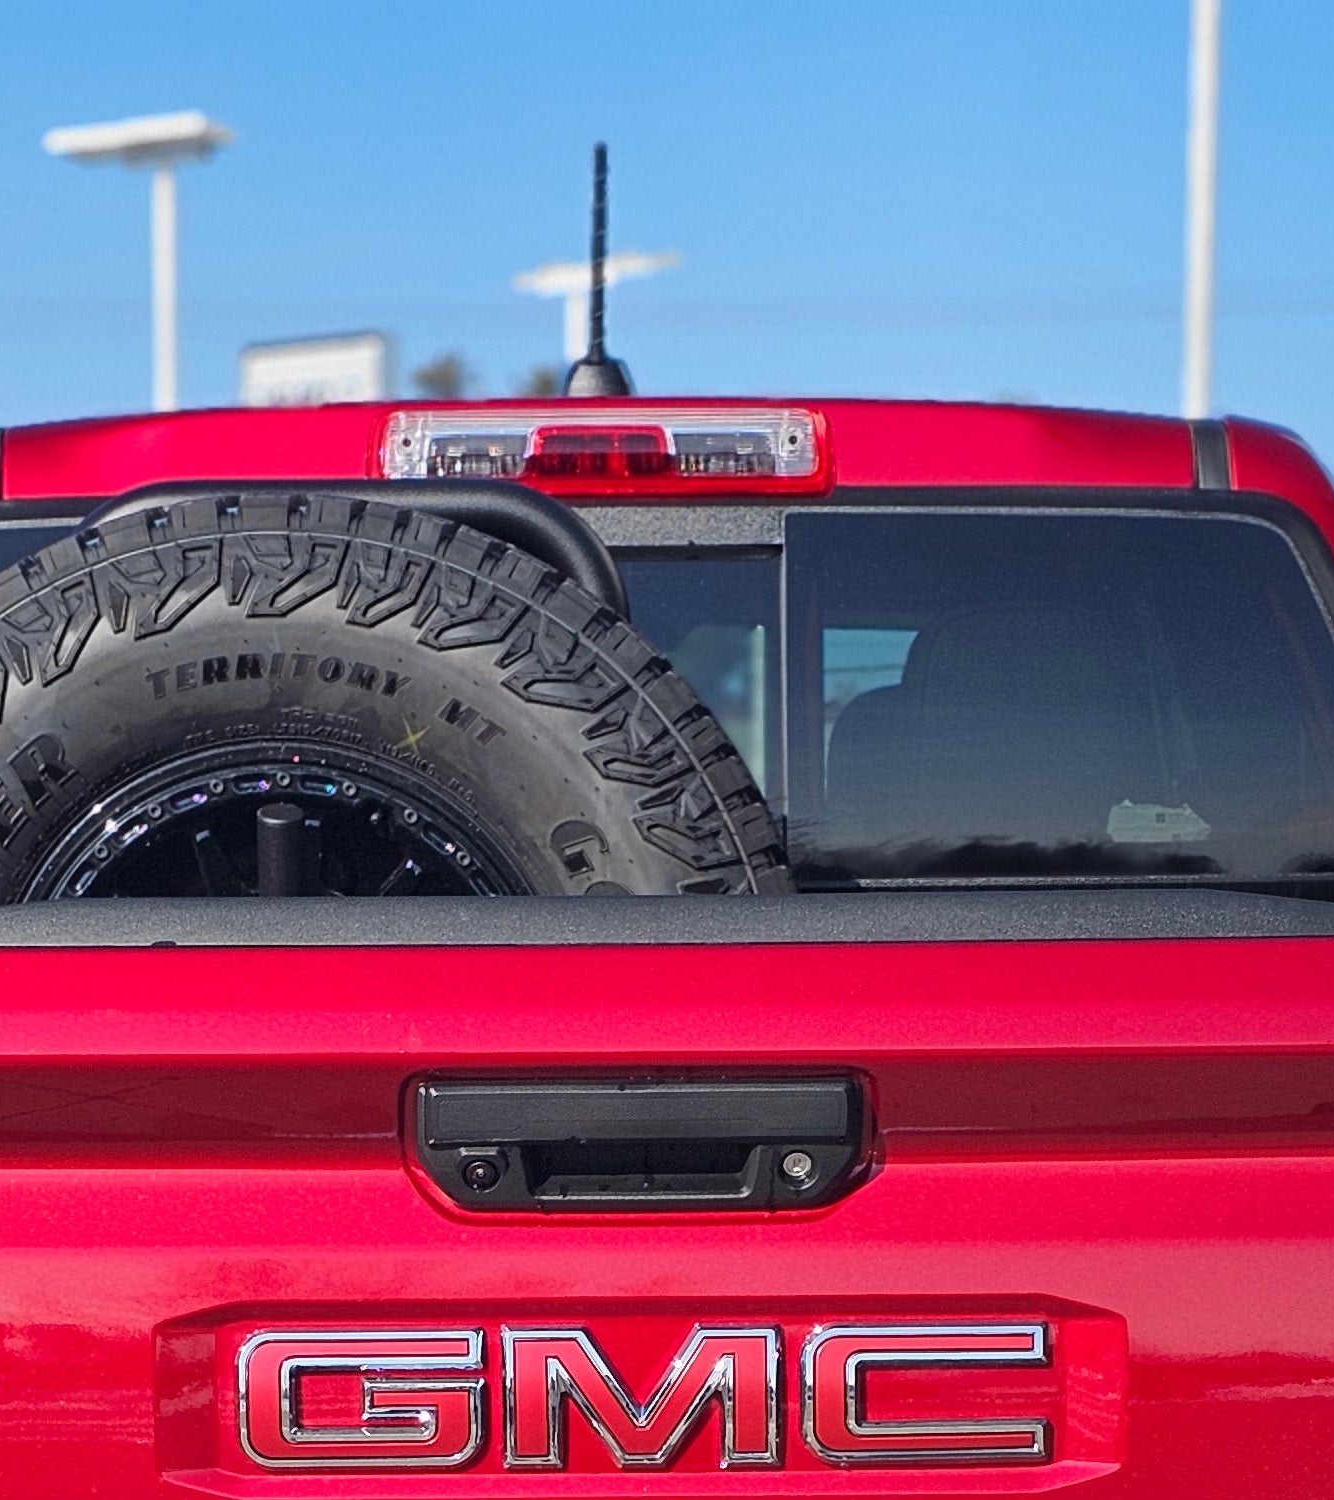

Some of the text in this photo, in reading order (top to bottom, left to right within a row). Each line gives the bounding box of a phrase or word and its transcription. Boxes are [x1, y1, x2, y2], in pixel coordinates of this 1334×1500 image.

[145, 652, 508, 746] TERRITORY MT
[237, 1323, 1050, 1469] GMC
